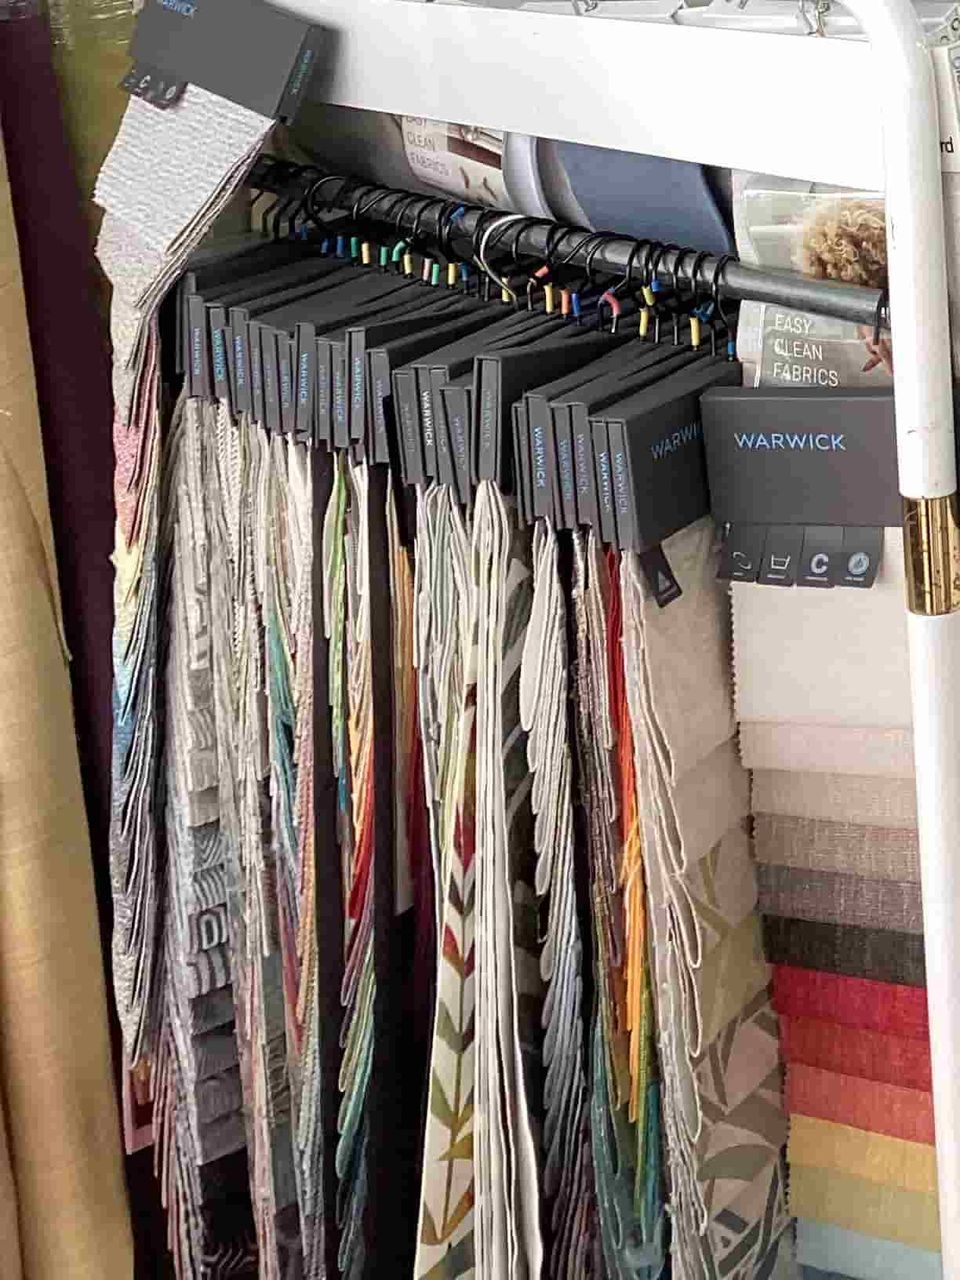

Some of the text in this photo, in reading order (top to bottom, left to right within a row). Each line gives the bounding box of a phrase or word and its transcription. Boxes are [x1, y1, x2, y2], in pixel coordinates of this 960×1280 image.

[774, 338, 823, 361] CLEAN
[775, 313, 812, 334] EASY
[213, 328, 226, 383] WARWICK
[301, 352, 310, 405] WARWICK
[773, 362, 840, 387] FABRICS
[421, 390, 434, 447] WARWICK
[650, 422, 698, 460] WARWI
[734, 433, 847, 452] WARWICK
[533, 426, 547, 489] WARWICK
[576, 433, 590, 496] WARWICK
[614, 452, 629, 514] WARWICK
